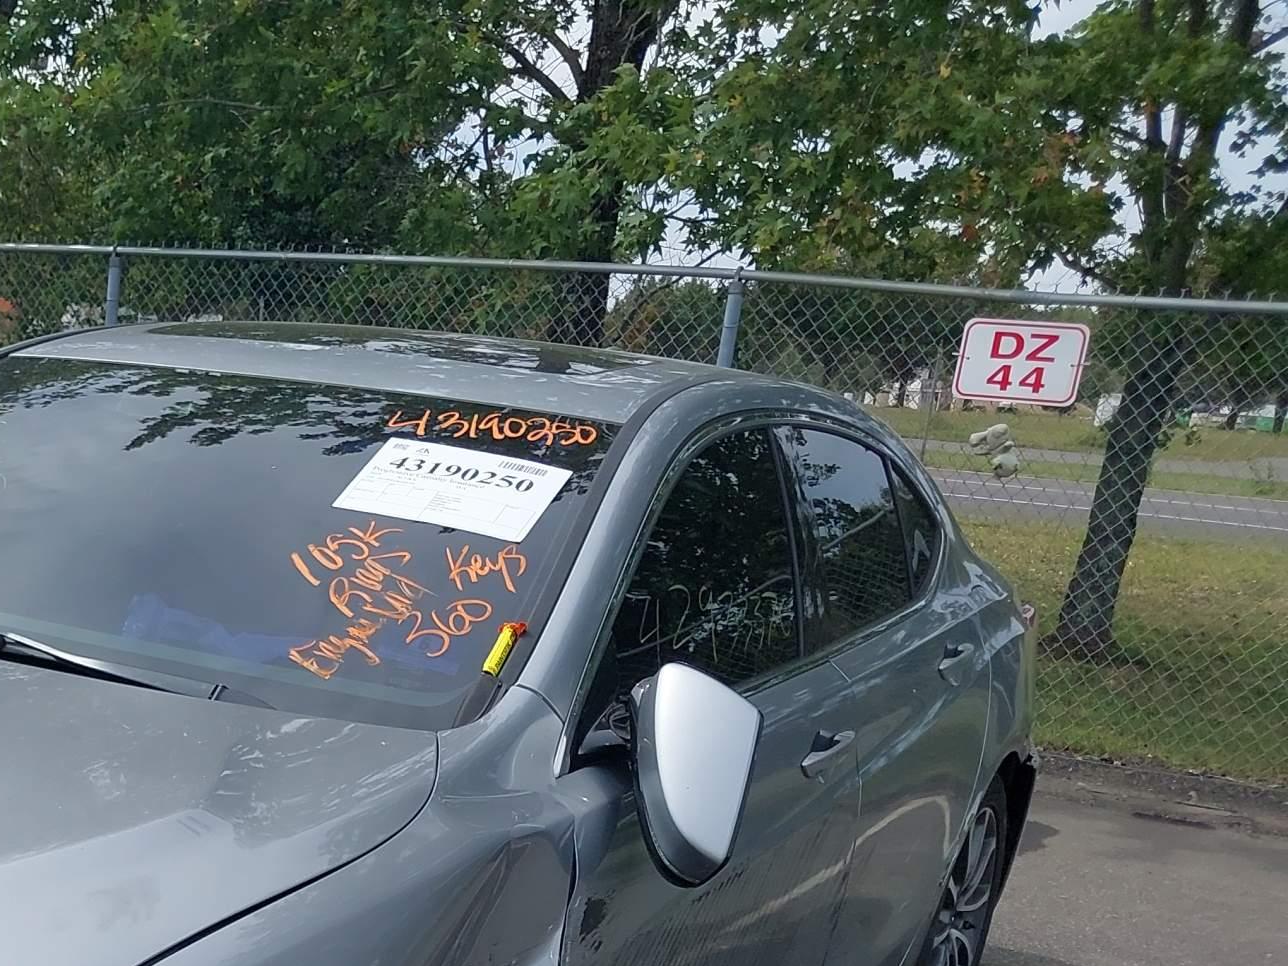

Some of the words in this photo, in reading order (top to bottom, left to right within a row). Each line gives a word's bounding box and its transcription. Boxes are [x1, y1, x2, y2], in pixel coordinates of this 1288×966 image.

[990, 331, 1060, 363] DZ
[986, 364, 1045, 394] 44
[387, 408, 598, 446] 43190250
[389, 456, 535, 493] 43190250
[290, 520, 404, 586] 105K
[445, 544, 527, 593] Keys
[405, 599, 493, 658] 360
